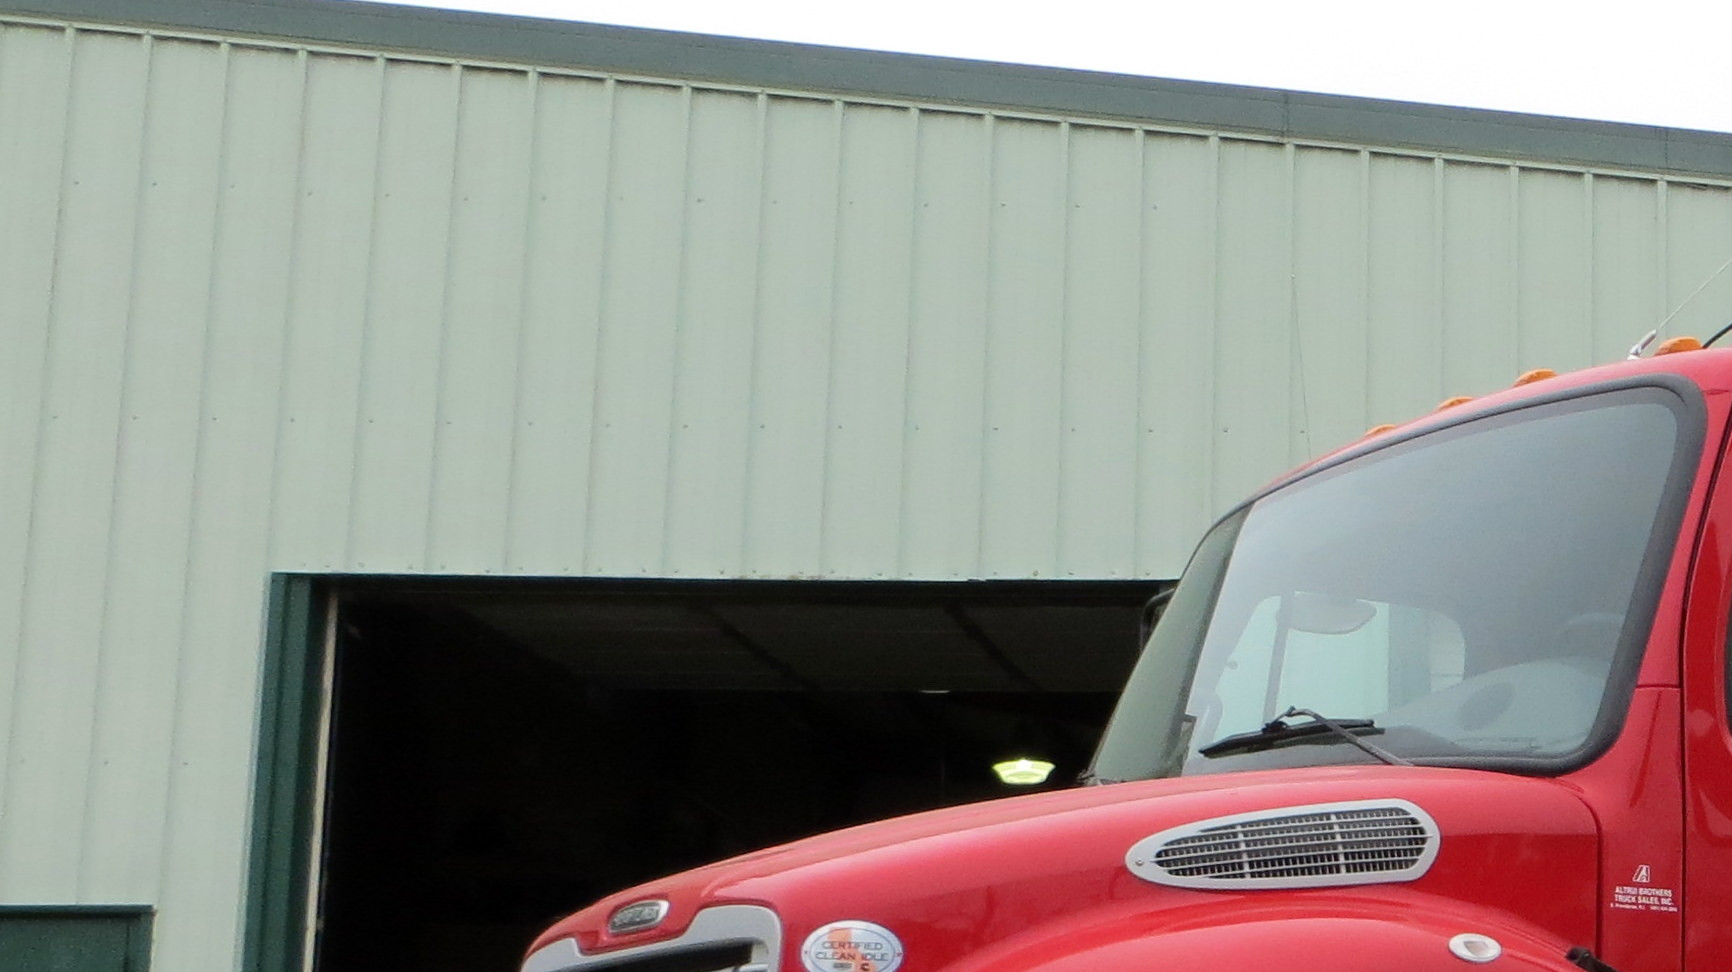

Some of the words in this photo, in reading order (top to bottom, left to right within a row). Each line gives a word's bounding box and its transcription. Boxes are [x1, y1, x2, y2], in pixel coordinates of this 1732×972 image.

[822, 941, 883, 951] CERTIFIED
[815, 951, 856, 961] CLEAN
[861, 952, 889, 961] IDLE
